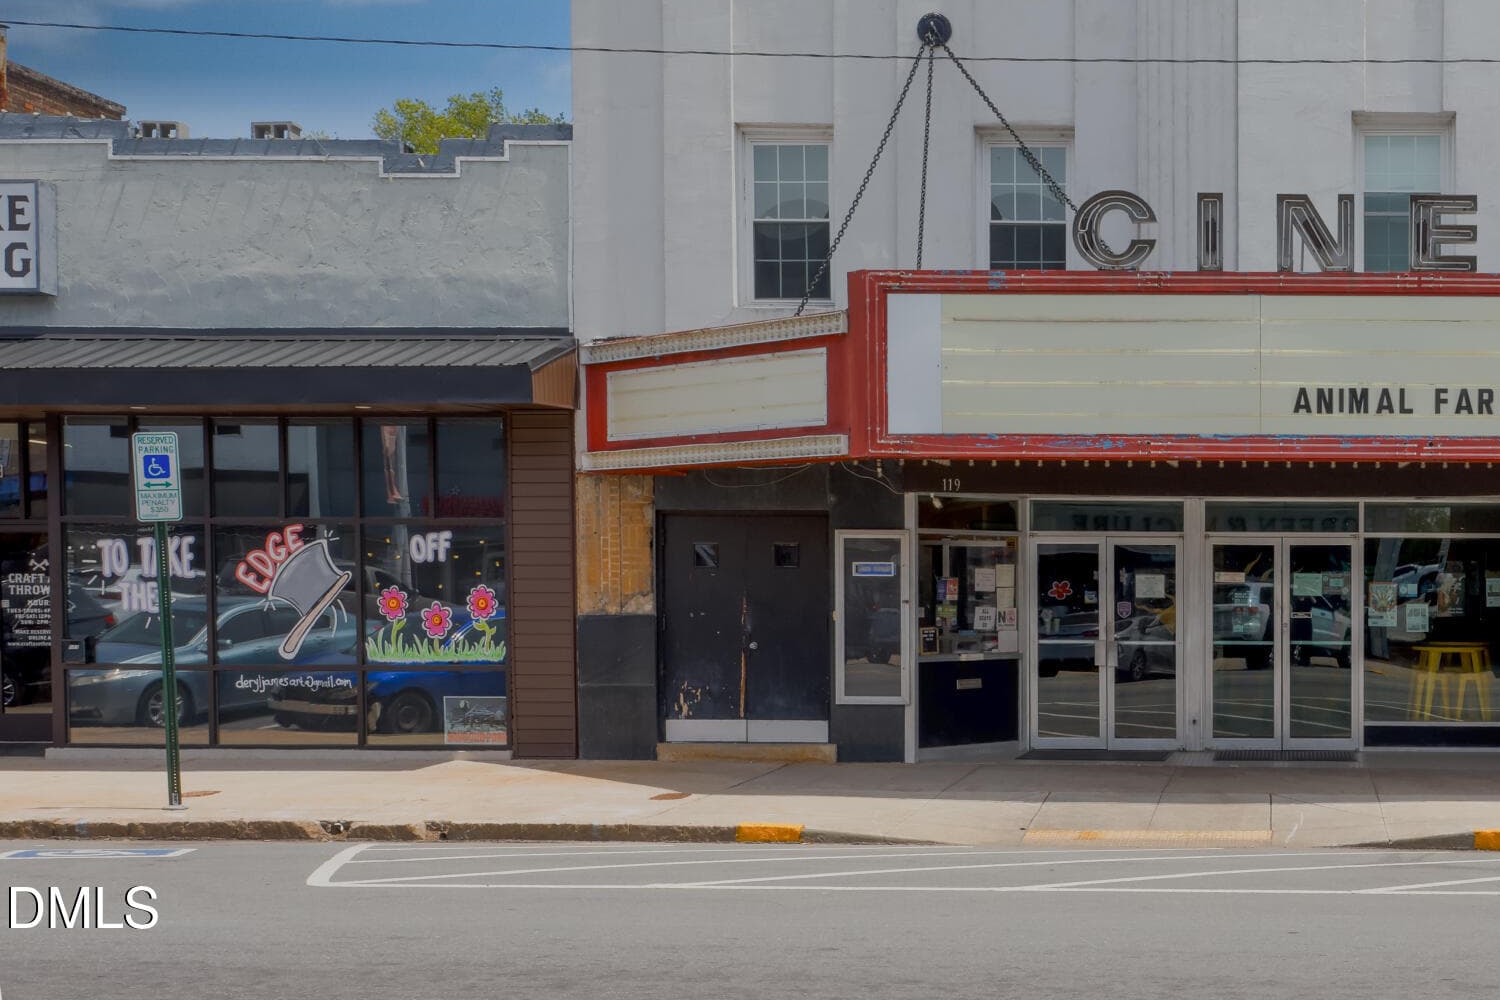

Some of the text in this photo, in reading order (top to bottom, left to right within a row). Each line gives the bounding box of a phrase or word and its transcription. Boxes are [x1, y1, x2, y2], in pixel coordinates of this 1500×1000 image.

[0, 195, 31, 231] E
[1293, 387, 1414, 415] ANIMAL
[137, 436, 174, 444] RESERVED
[942, 478, 961, 491] 119
[97, 538, 129, 578] TO
[235, 523, 304, 594] EDGE
[409, 530, 453, 564] OFF
[8, 573, 45, 584] CRAFT
[119, 581, 160, 613] THE
